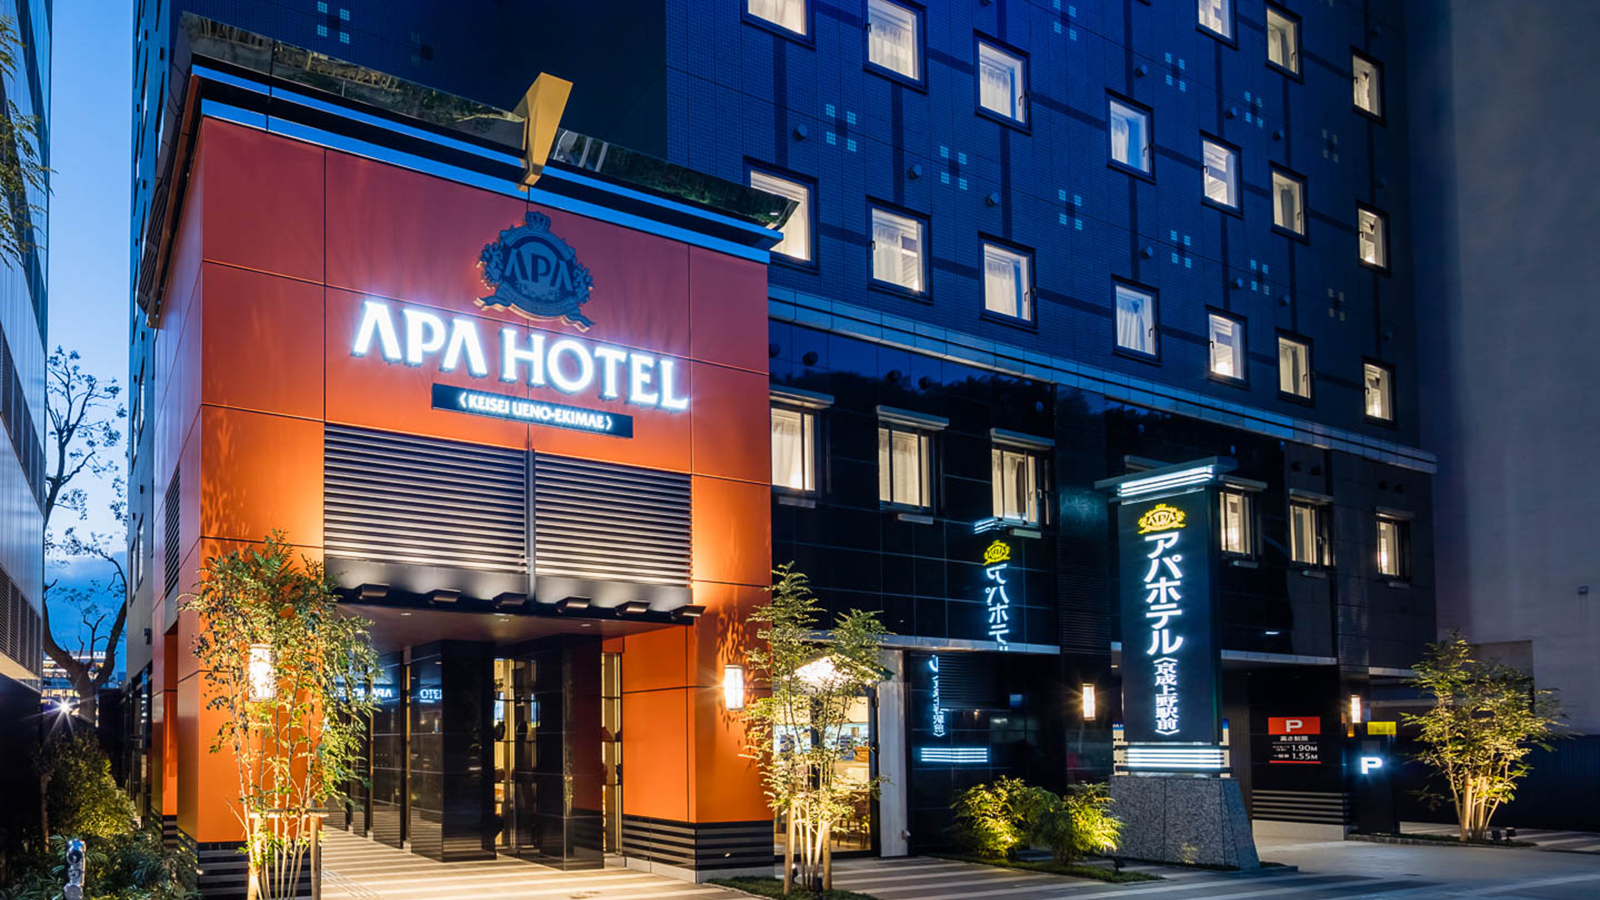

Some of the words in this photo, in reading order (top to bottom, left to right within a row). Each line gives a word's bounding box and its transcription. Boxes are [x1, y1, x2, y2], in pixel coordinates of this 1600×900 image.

[503, 248, 574, 292] APA
[352, 300, 488, 378] APA
[499, 326, 690, 412] HOTEL
[1144, 531, 1184, 656] アパホテル
[1285, 719, 1303, 733] P
[1291, 744, 1318, 752] 1.90M
[1291, 752, 1319, 760] 1.55M
[1361, 756, 1383, 775] P
